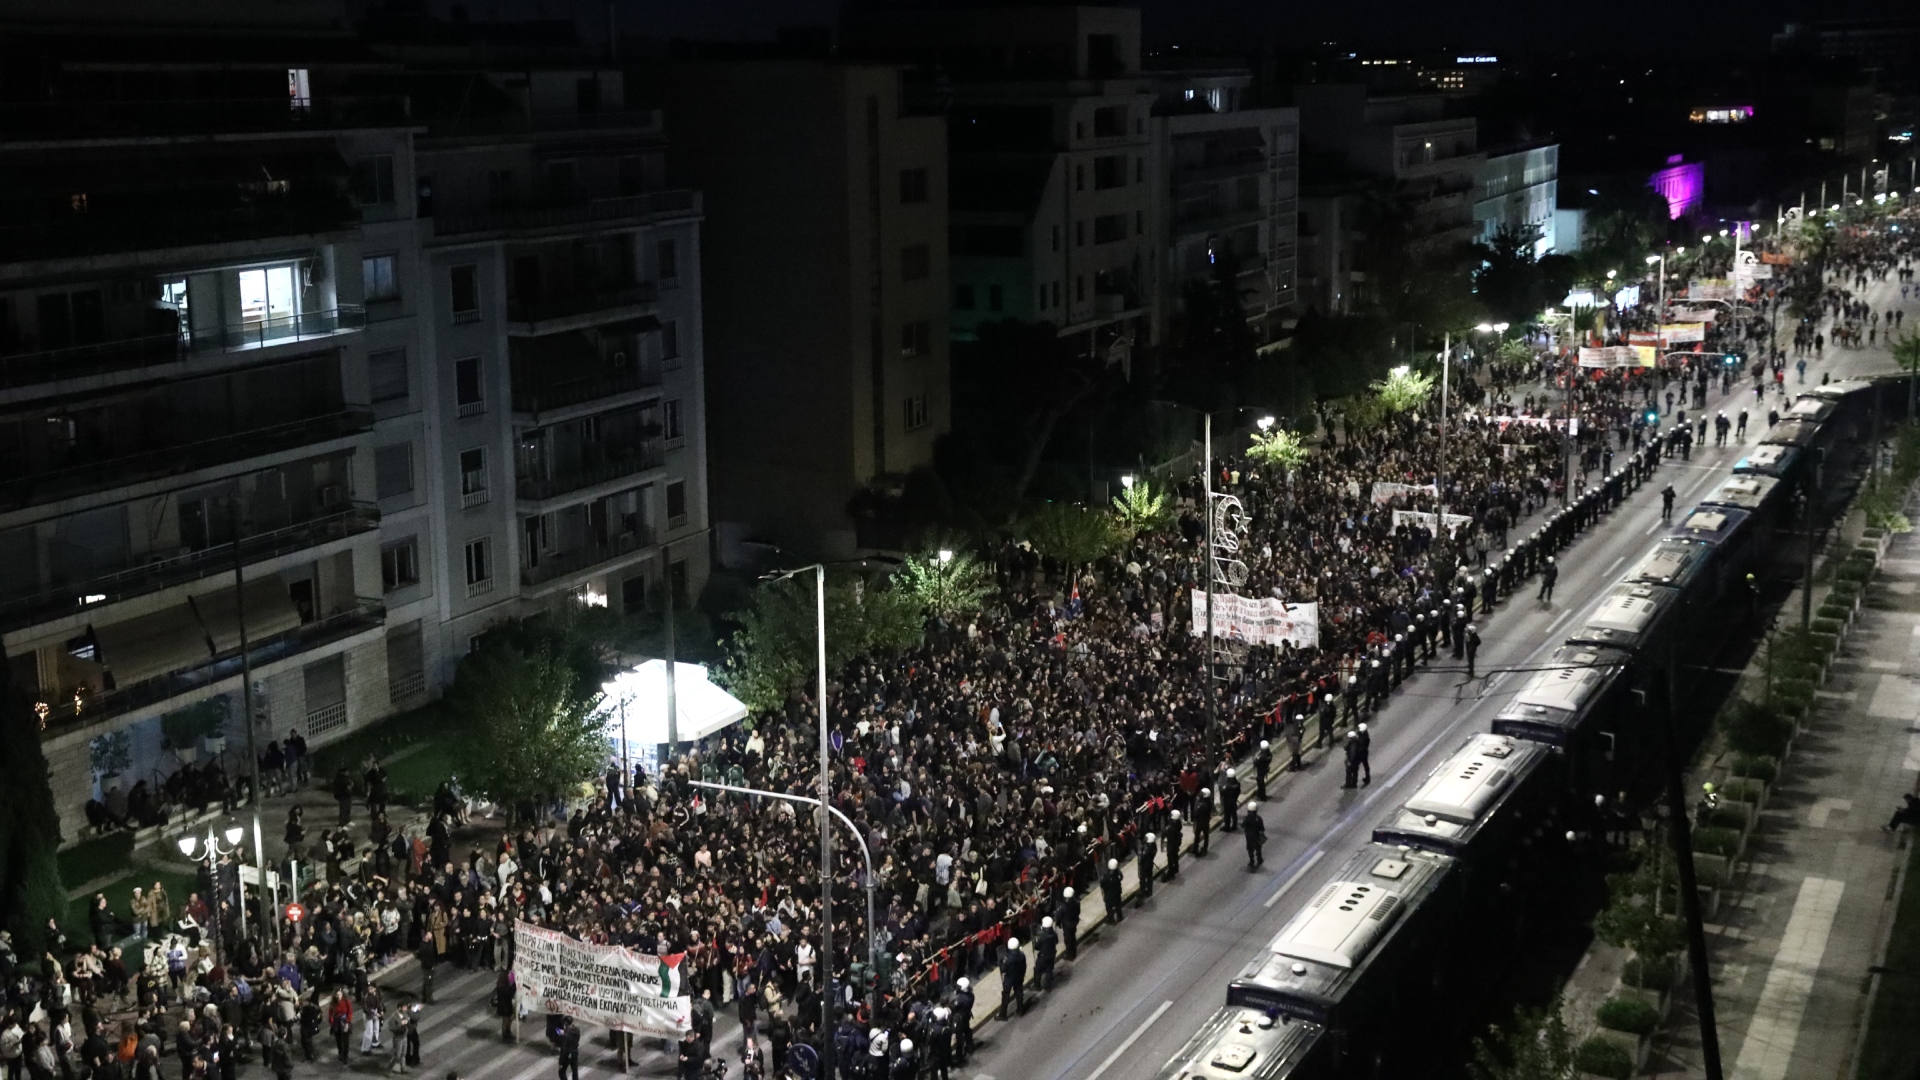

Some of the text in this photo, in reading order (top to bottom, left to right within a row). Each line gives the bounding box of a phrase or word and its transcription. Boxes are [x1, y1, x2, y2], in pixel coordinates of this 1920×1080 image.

[542, 963, 556, 974] ΜΑΣ
[572, 994, 598, 1010] ΔΩΡΕΑΝ
[599, 999, 642, 1016] ΕΚΠΑΙΔΕΥΣΗ
